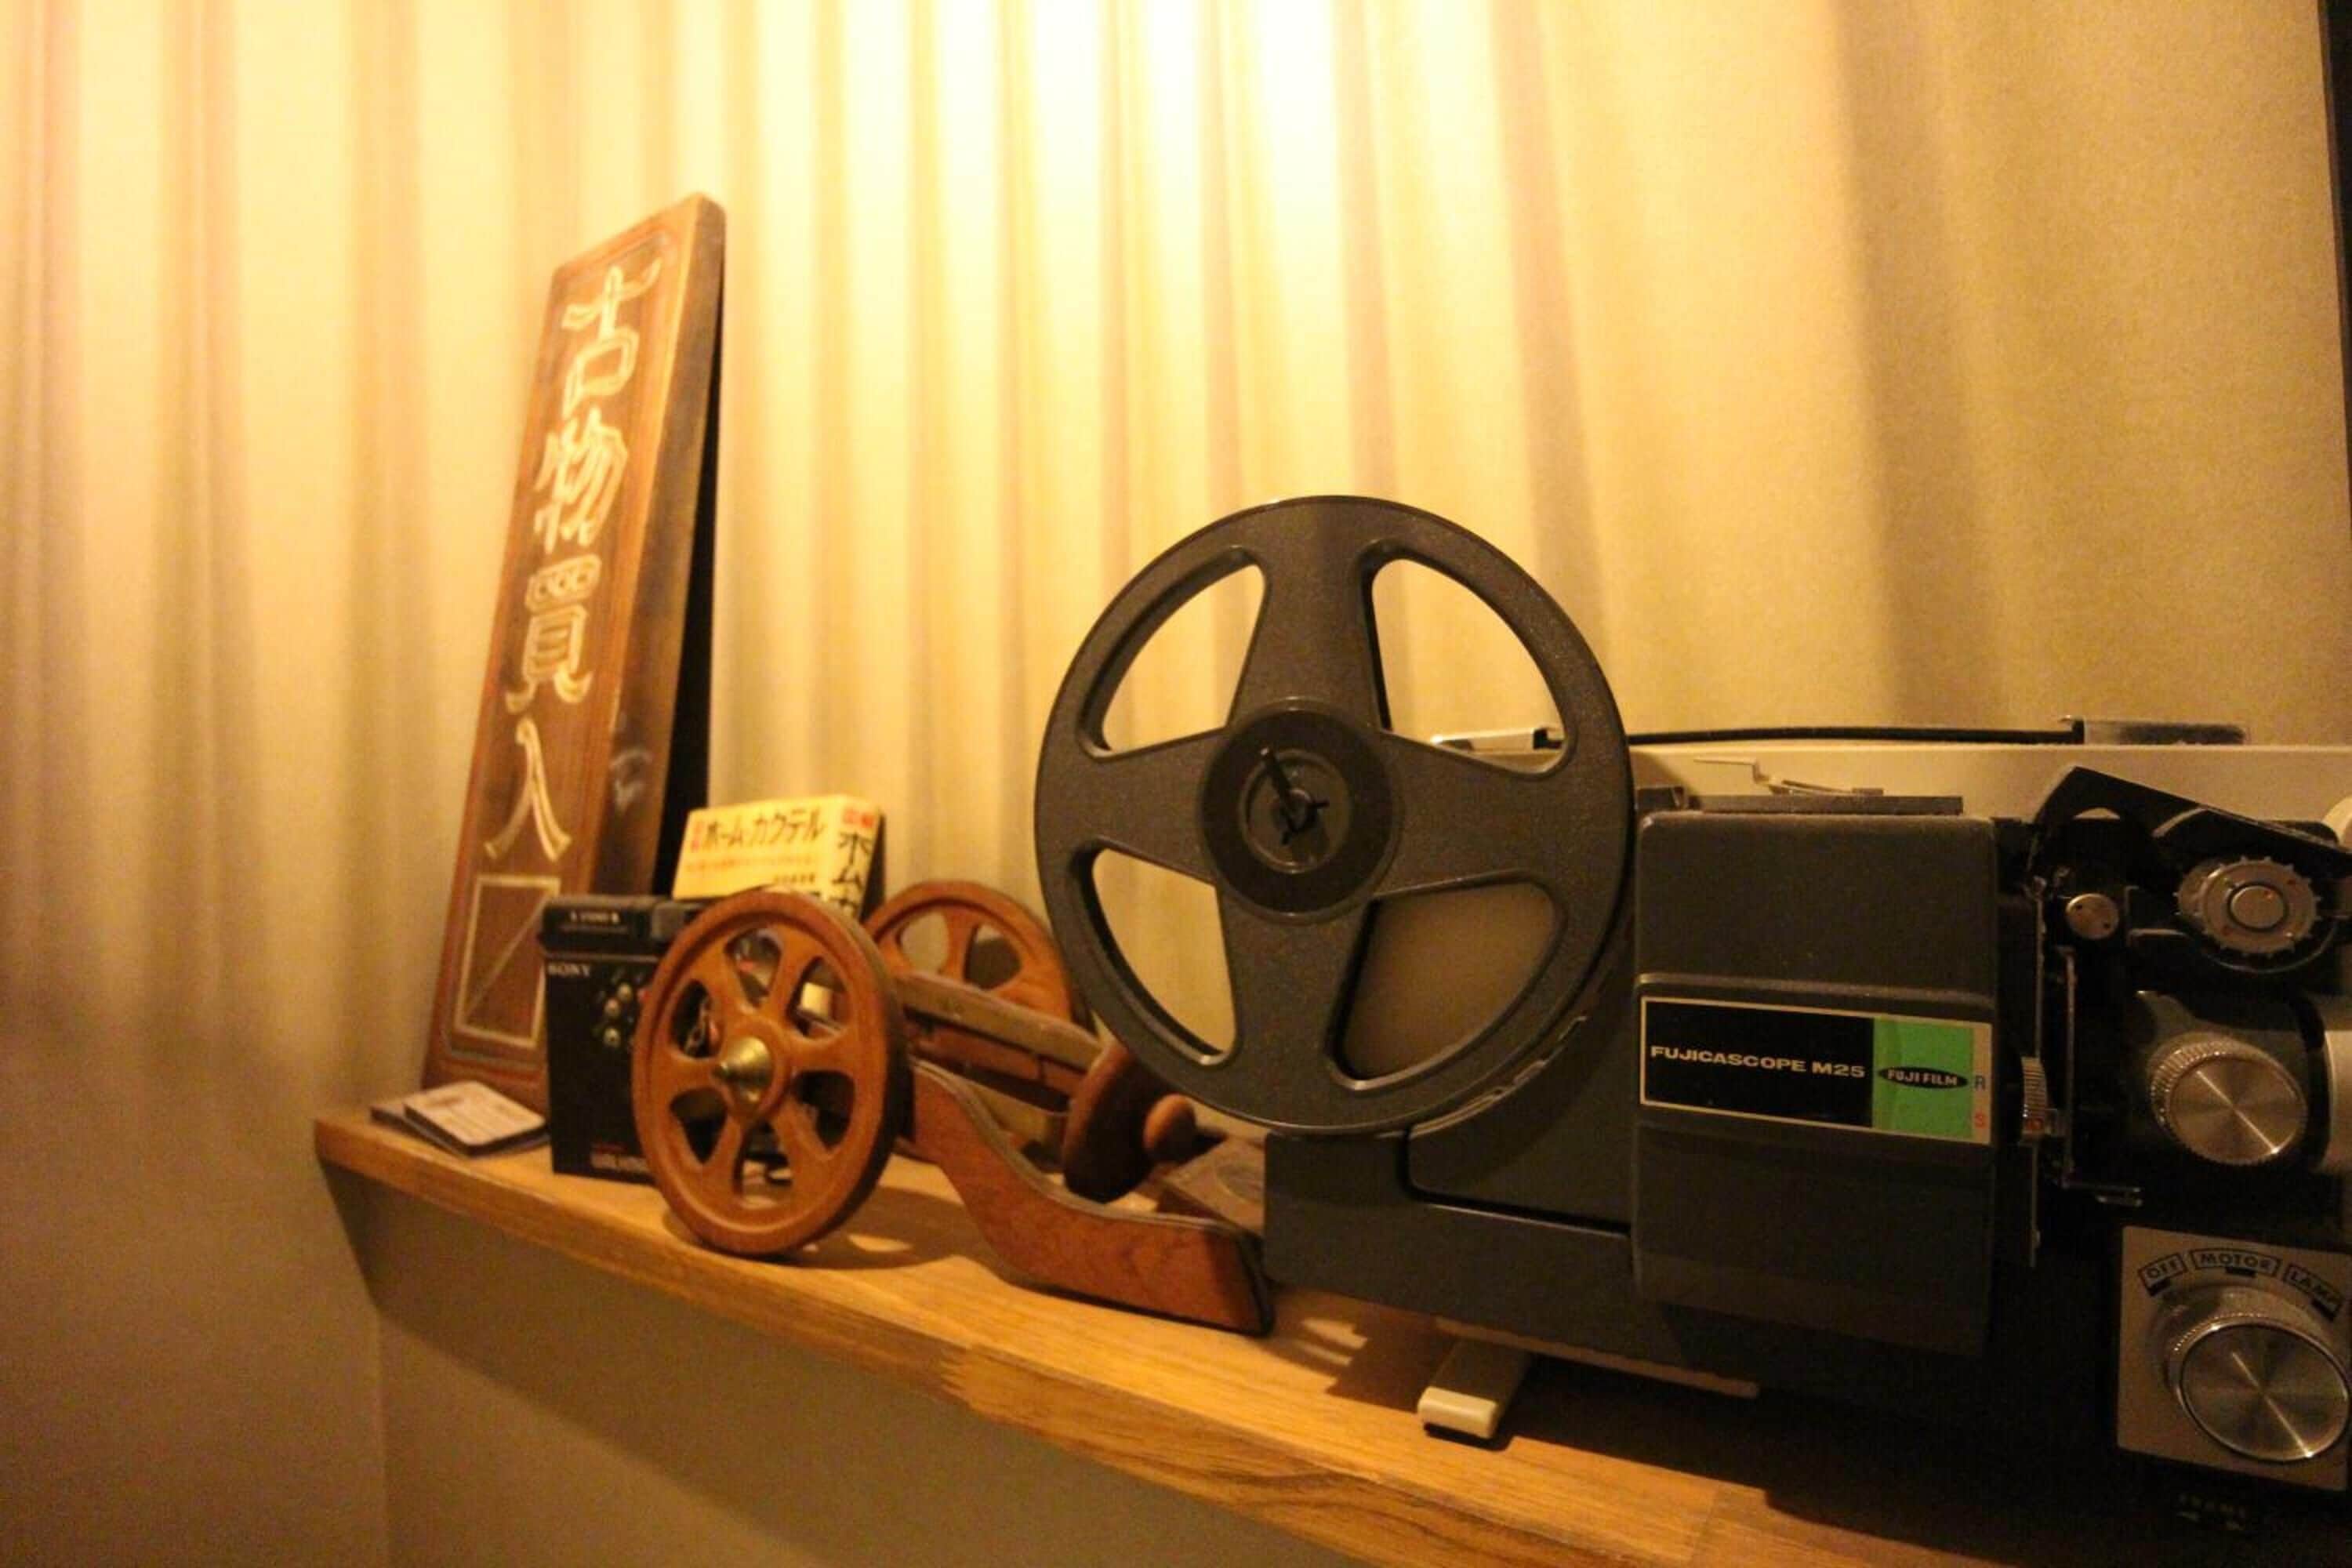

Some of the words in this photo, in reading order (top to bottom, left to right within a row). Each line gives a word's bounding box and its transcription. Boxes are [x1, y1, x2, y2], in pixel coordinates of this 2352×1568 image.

[548, 960, 587, 976] SONY
[1650, 1045, 1806, 1073] FUJICASCOPE
[1812, 1061, 1865, 1079] M25
[1975, 1076, 1986, 1091] R
[2146, 1258, 2178, 1279] OFF
[2200, 1253, 2271, 1270] MOTOR
